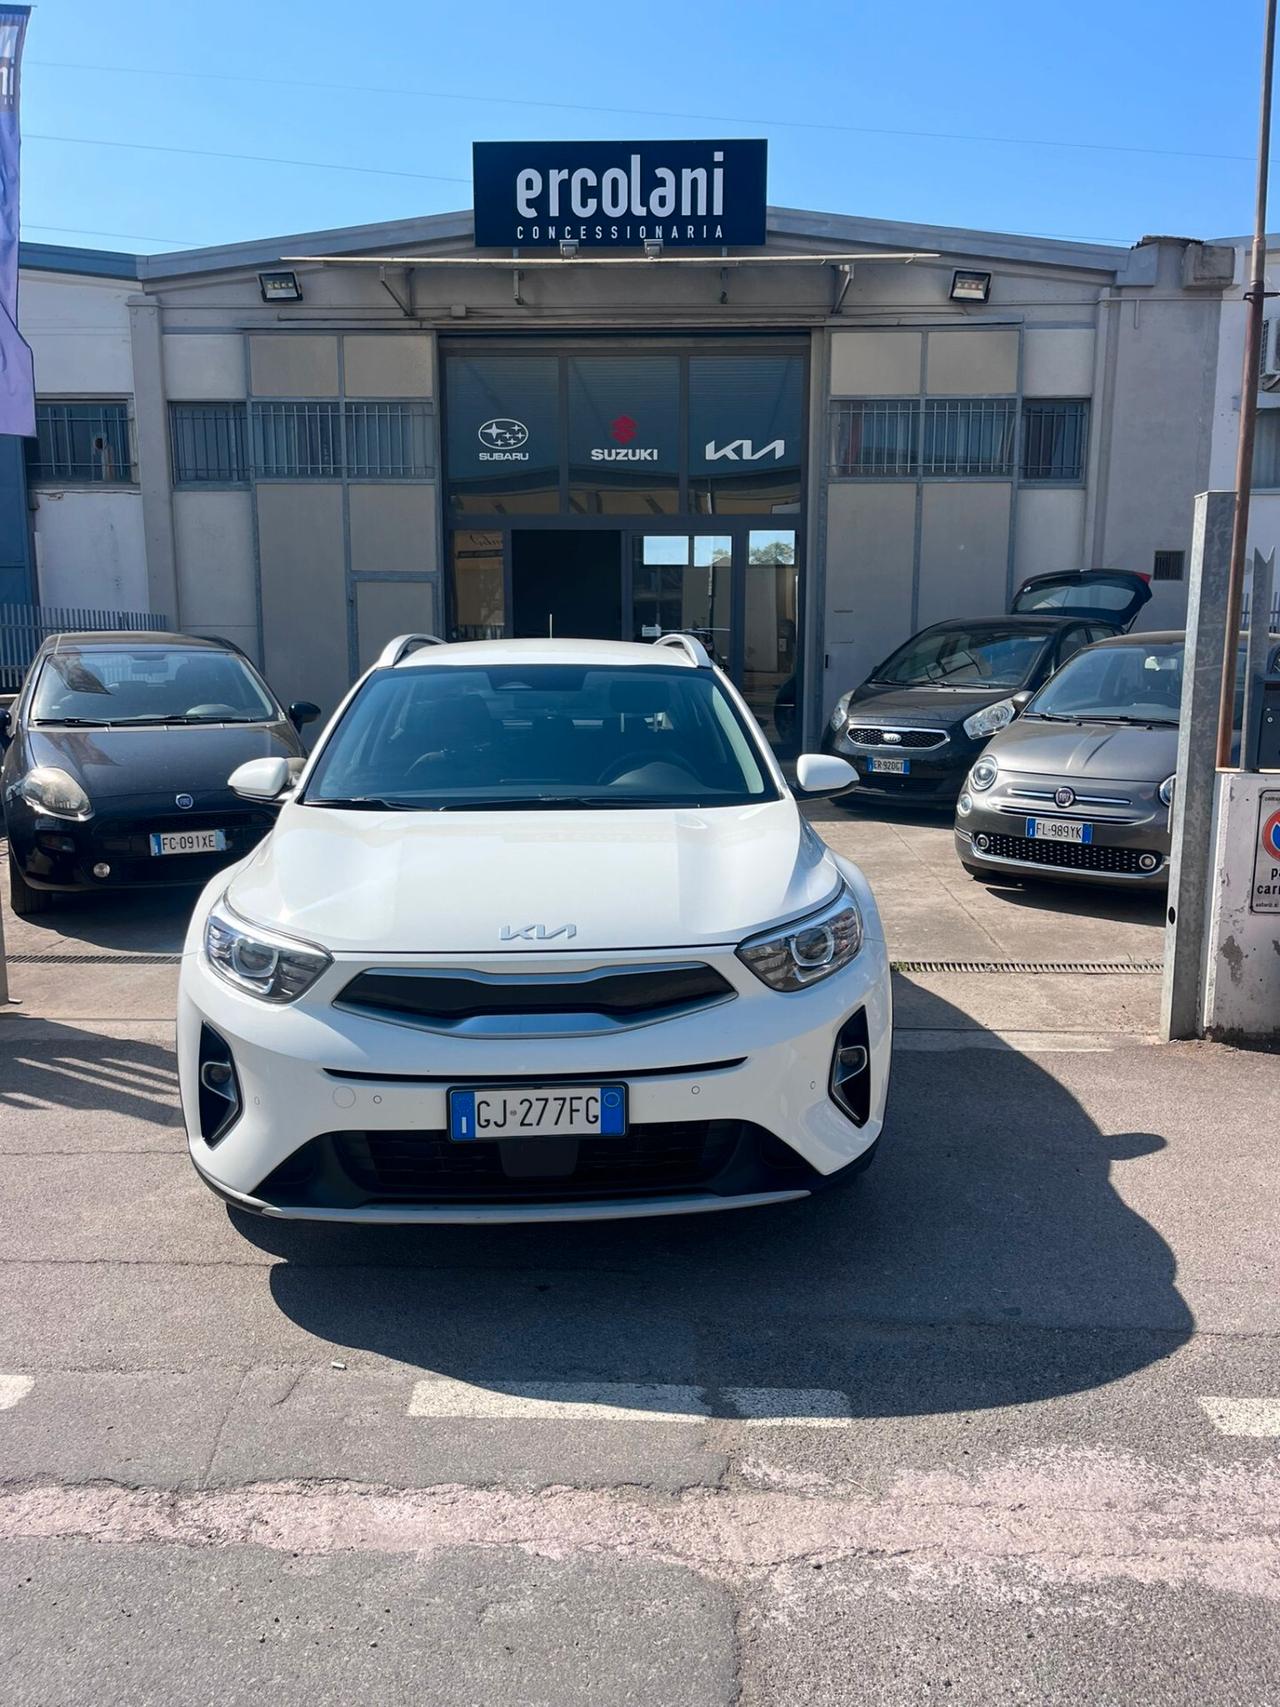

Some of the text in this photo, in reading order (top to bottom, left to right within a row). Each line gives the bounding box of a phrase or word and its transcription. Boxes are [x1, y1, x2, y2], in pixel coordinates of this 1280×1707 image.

[516, 151, 724, 218] ercolani
[516, 224, 723, 240] CONCESSIONARIA
[478, 452, 530, 461] SUBARU
[591, 448, 658, 461] SUZUKI
